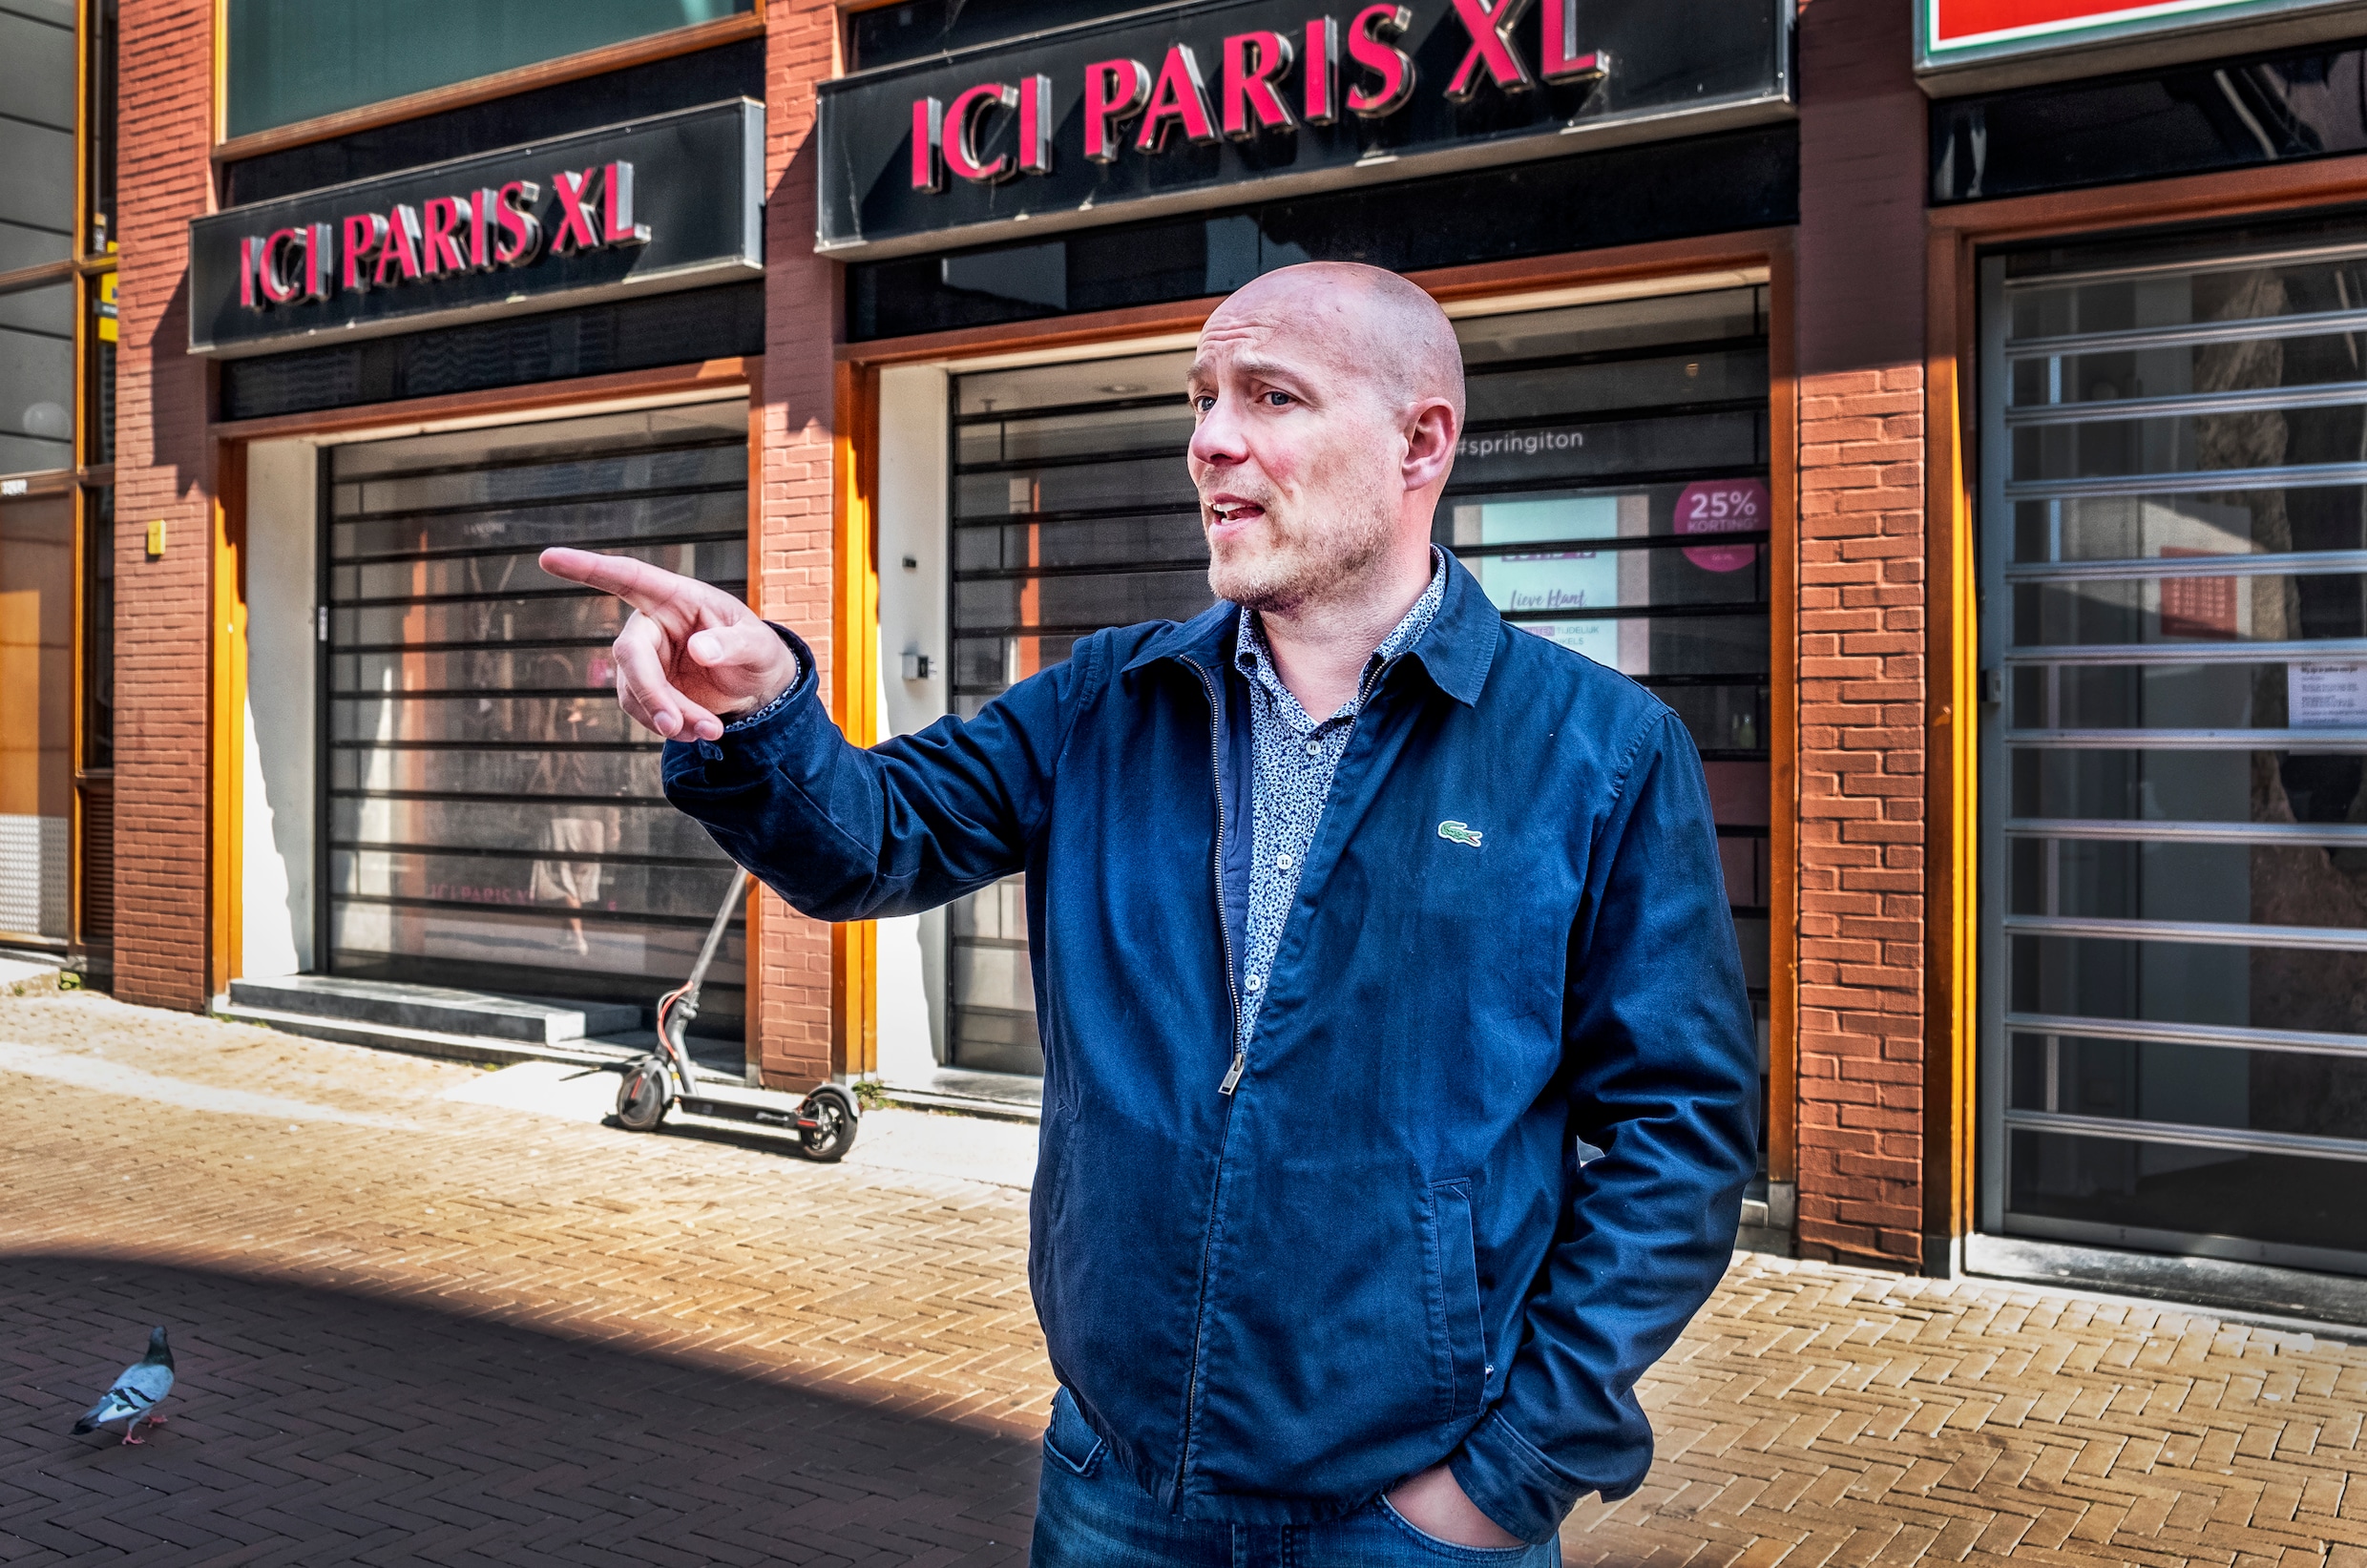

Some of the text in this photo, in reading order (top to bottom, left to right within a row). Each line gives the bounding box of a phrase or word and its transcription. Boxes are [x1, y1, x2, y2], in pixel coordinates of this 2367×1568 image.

[911, 0, 1611, 194] ICI PARIS XL
[241, 158, 652, 312] ICI PARIS XL
[1456, 431, 1584, 458] #springiton
[1688, 489, 1757, 519] 25%
